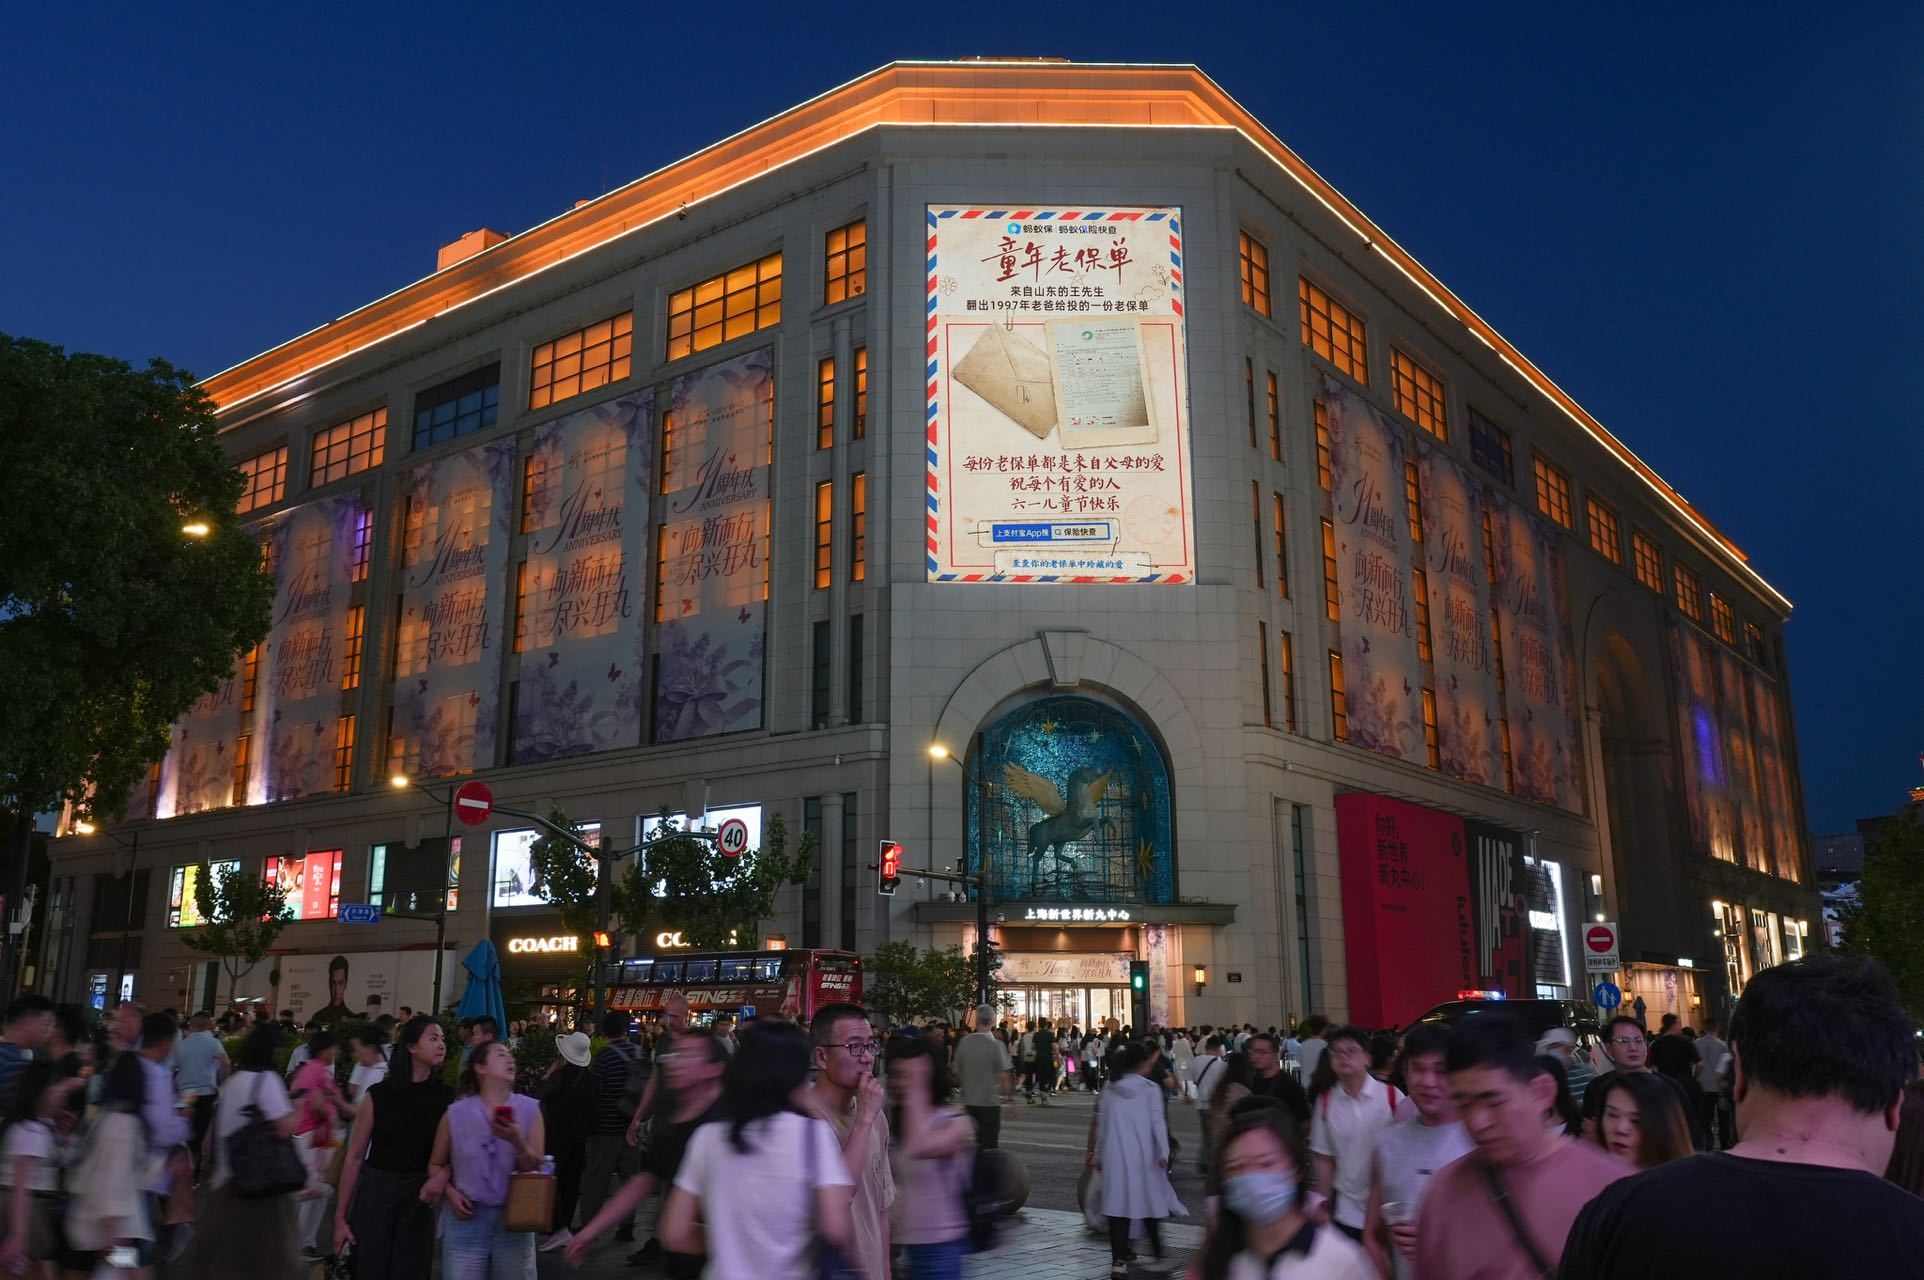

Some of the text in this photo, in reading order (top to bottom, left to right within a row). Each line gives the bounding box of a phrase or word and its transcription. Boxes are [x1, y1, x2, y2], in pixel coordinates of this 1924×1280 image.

[1022, 224, 1117, 235] 蚂蚁保 蚂蚁保险快查
[981, 236, 1134, 285] 童年老保单
[1010, 286, 1104, 297] 来自山东的王先生
[966, 299, 1149, 312] 翻出1997年老爸给投的一份老保单
[962, 454, 1165, 472] 每份老保单都是来自父母的爱
[1010, 475, 1121, 492] 祝每个有爱的人
[700, 487, 757, 511] ANNIVERSARY
[1011, 494, 1120, 513] 六一儿童节快乐
[563, 528, 623, 552] ANNIVERSARY
[681, 511, 756, 554] 向新而行
[996, 528, 1049, 538] 上支付宝App搜
[1064, 527, 1096, 537] 保险快查
[548, 552, 628, 600] 向新而行
[724, 830, 743, 848] 40
[1376, 839, 1409, 864] 新世界
[1024, 908, 1130, 921] 上海新世界新丸中心
[1478, 835, 1514, 977] MADE
[508, 936, 578, 953] COACH
[612, 989, 655, 1008] 能量就位
